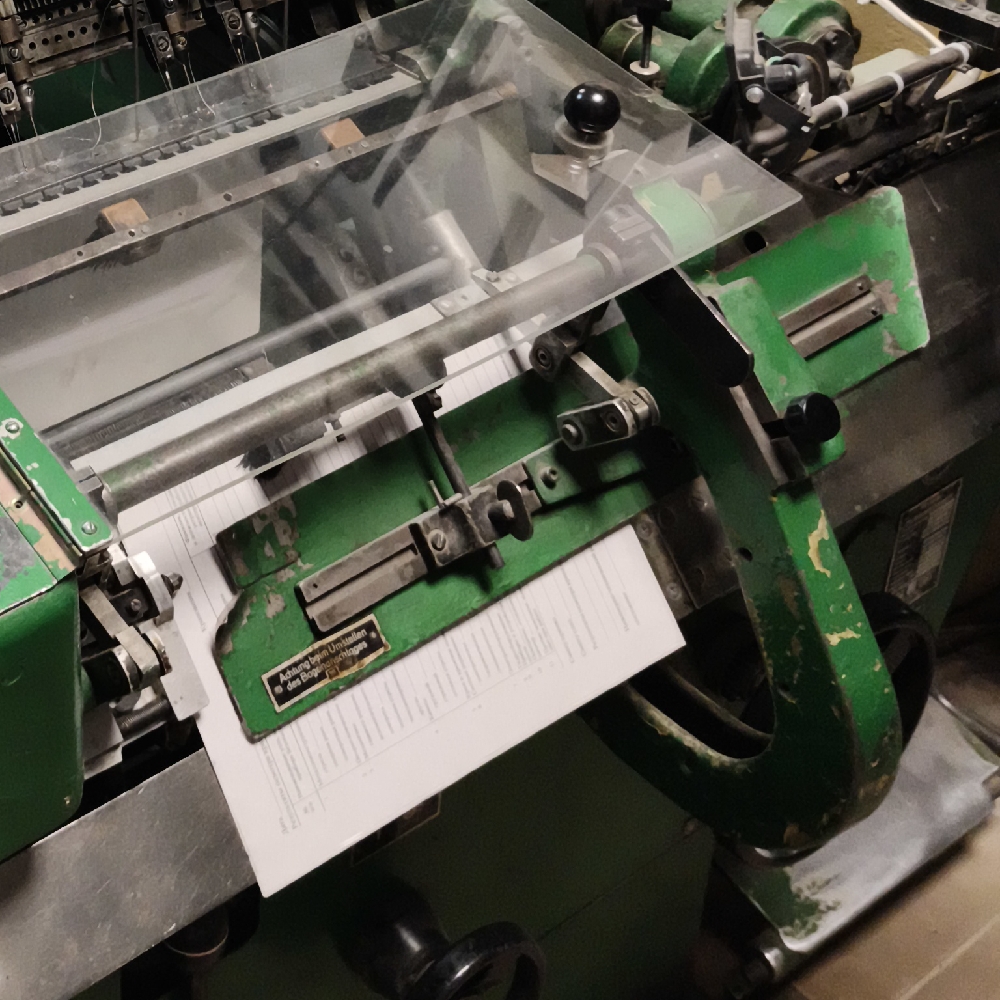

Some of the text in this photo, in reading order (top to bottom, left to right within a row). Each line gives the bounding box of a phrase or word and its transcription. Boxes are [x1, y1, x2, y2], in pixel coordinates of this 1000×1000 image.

[279, 629, 368, 684] Achtung beim Umstellen
[286, 677, 302, 691] des
